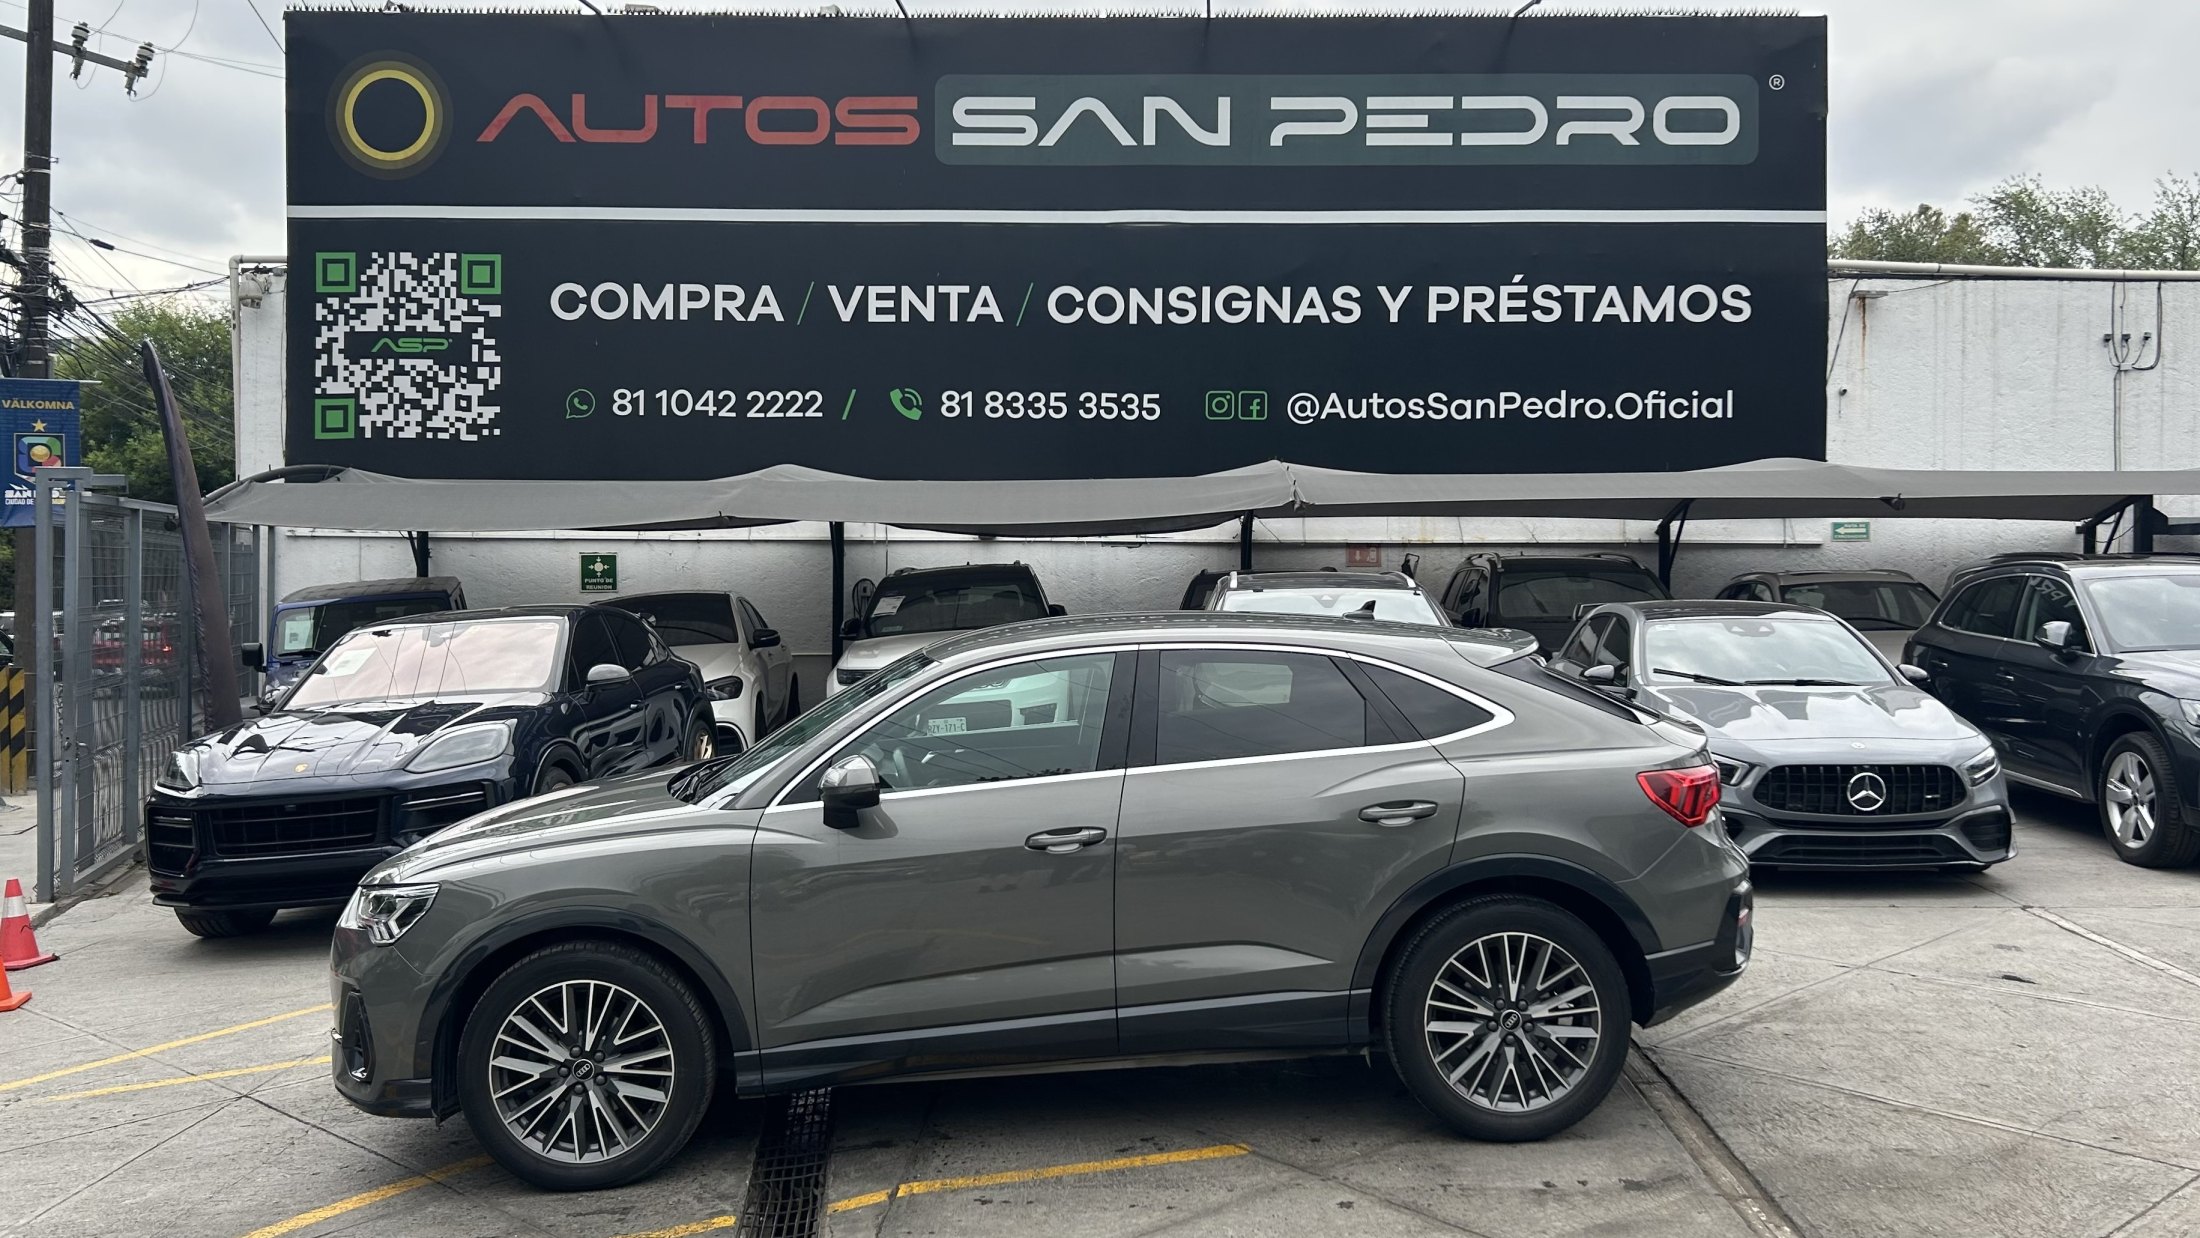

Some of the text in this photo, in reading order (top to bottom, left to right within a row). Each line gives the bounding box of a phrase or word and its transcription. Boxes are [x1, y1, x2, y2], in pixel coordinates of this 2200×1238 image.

[477, 93, 921, 146] AUTOS
[952, 96, 1231, 147] SAN
[1269, 95, 1741, 147] PEDRO
[550, 281, 785, 322] COMPRA
[827, 284, 1004, 323] VENTA
[1047, 285, 1362, 325] CONSIGNAS
[1376, 285, 1413, 323] Y
[1427, 274, 1752, 323] PRÉSTAMOS
[371, 337, 449, 353] ASP
[1, 398, 76, 410] VÄLKOMNA
[612, 388, 645, 416] 81
[655, 389, 737, 418] 1042
[746, 390, 823, 418] 2222
[940, 390, 1161, 421] 81 8335 3535
[1287, 389, 1733, 425] @AutosSanPedro.Oficial
